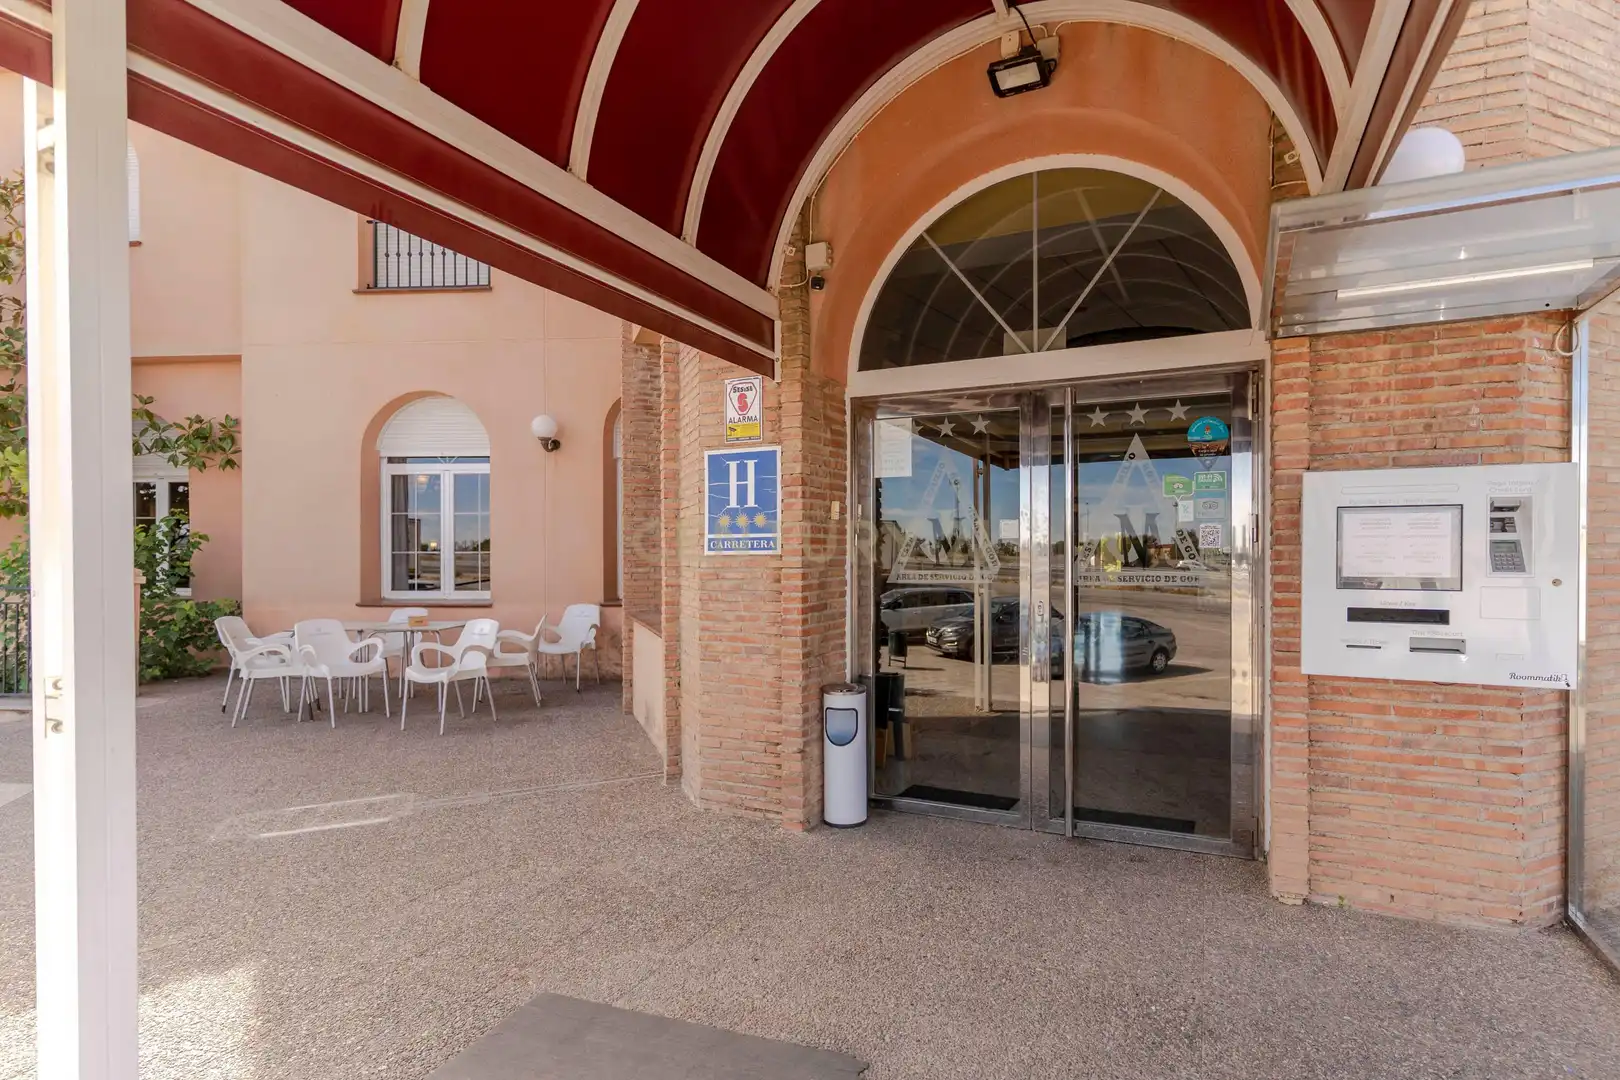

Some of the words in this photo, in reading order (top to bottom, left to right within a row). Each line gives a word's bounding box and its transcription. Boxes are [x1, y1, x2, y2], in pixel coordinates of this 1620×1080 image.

[728, 415, 759, 424] ALARMA
[726, 459, 758, 508] H
[710, 540, 776, 549] CARRETERA
[1509, 672, 1562, 682] Roommatik
